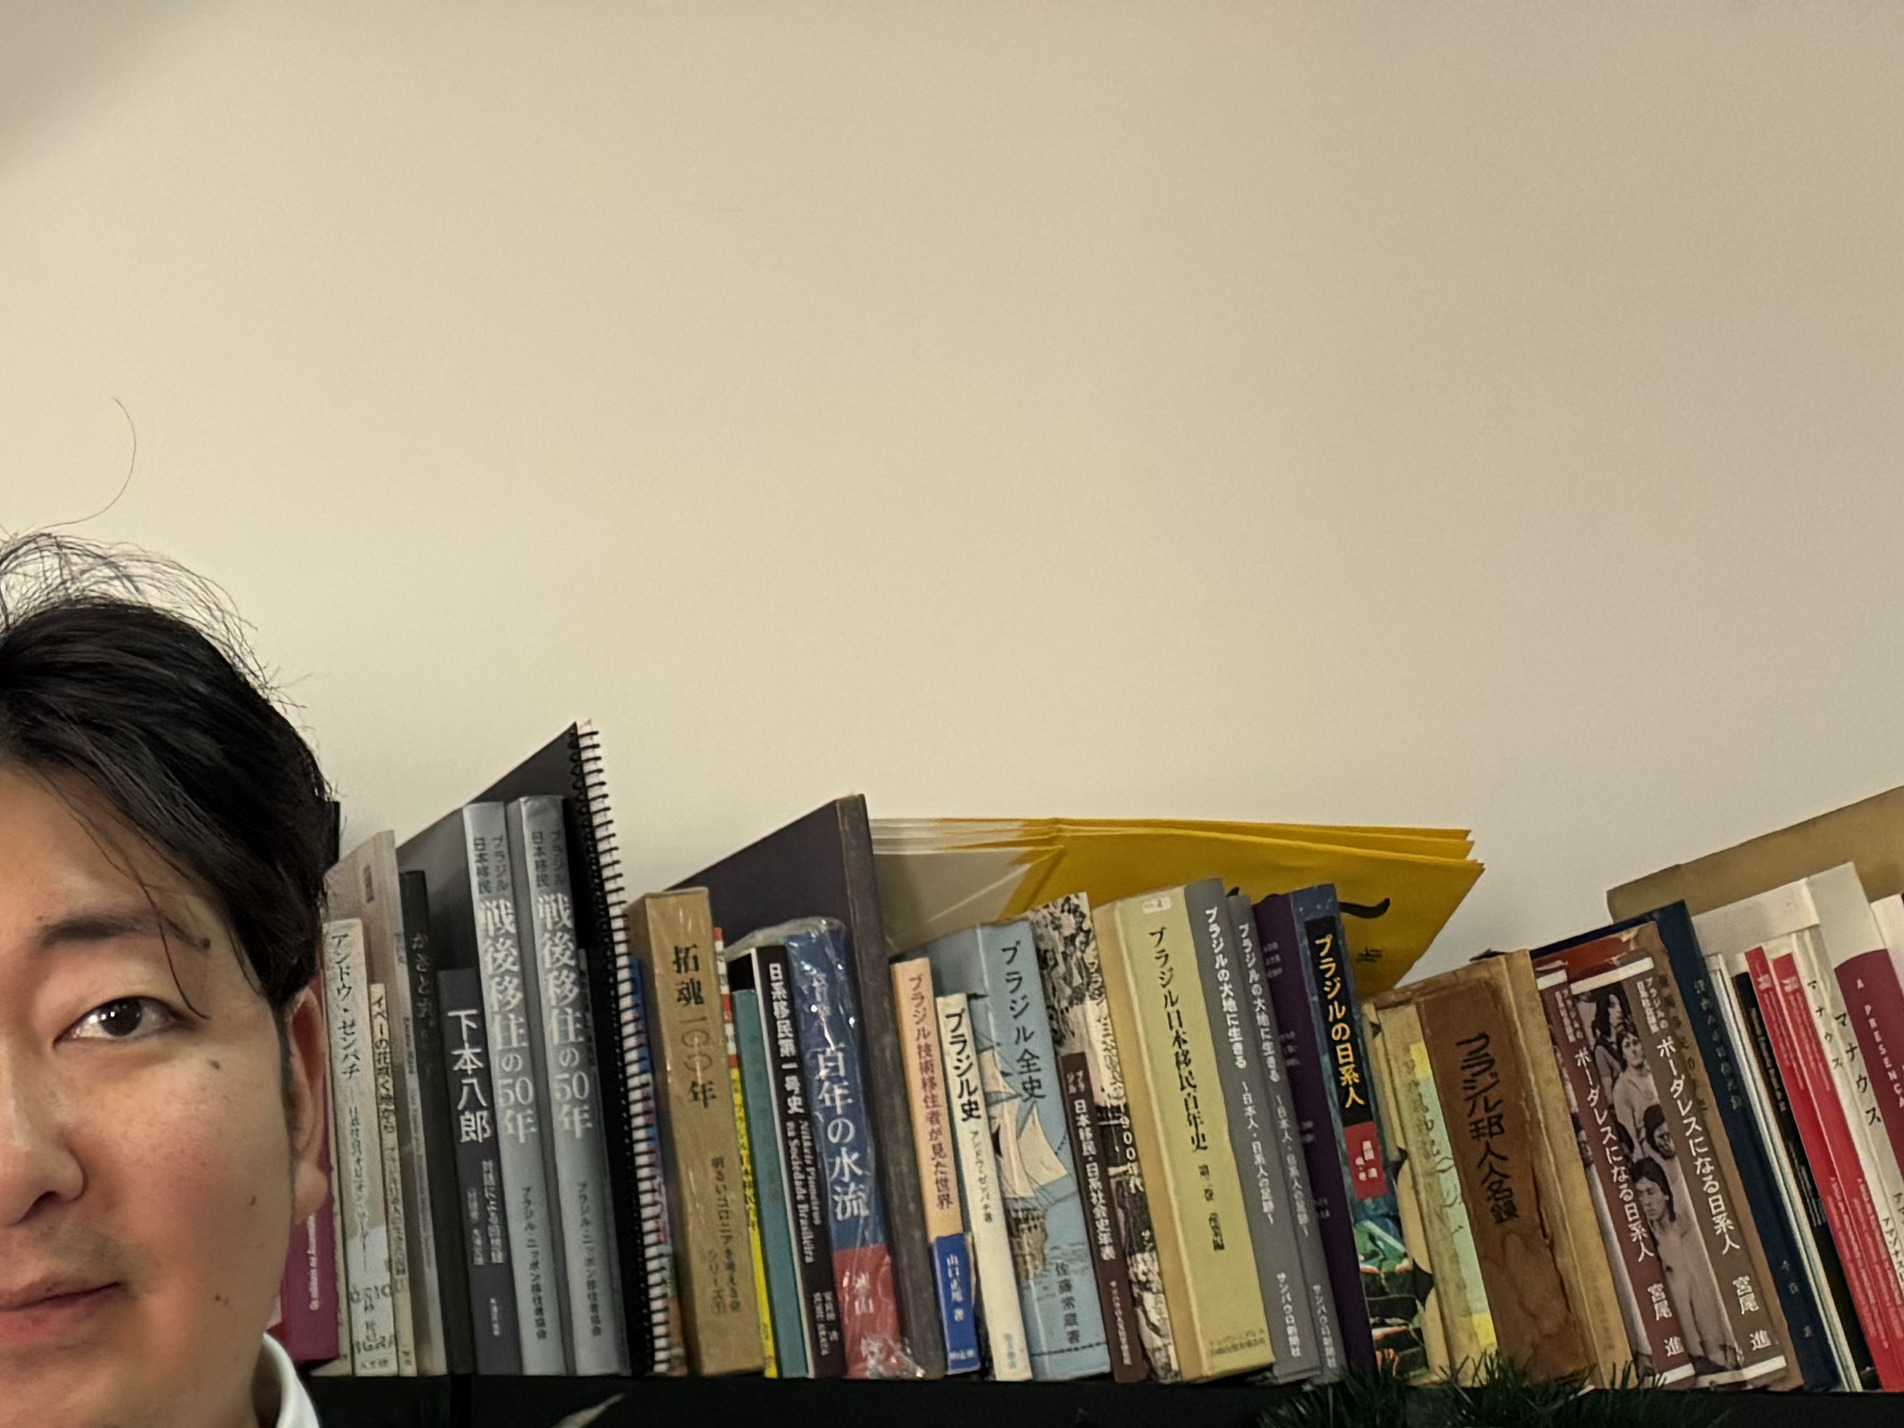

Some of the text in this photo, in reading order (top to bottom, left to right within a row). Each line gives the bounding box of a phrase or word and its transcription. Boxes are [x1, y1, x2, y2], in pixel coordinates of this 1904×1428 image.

[479, 900, 537, 1144] 戦後移住の50年
[537, 894, 592, 1139] 戦後移住の50年
[944, 1010, 982, 1122] ブラジル史
[1001, 939, 1047, 1101] ブラジル全史
[1148, 926, 1209, 1153] ブラジル日本移民百年史
[1206, 906, 1248, 1070] ブラジルの大地に生きる
[1238, 923, 1280, 1083] ブラジルの大地に生きる
[1314, 933, 1365, 1109] ブラジルの日系人
[1833, 1011, 1883, 1127] マナウス
[447, 1008, 492, 1145] 下本八郎
[815, 1048, 871, 1221] 百年の水流
[1574, 1046, 1654, 1264] ボーダレスになる日系人
[1656, 1036, 1741, 1254] ボーダレスになる日系人
